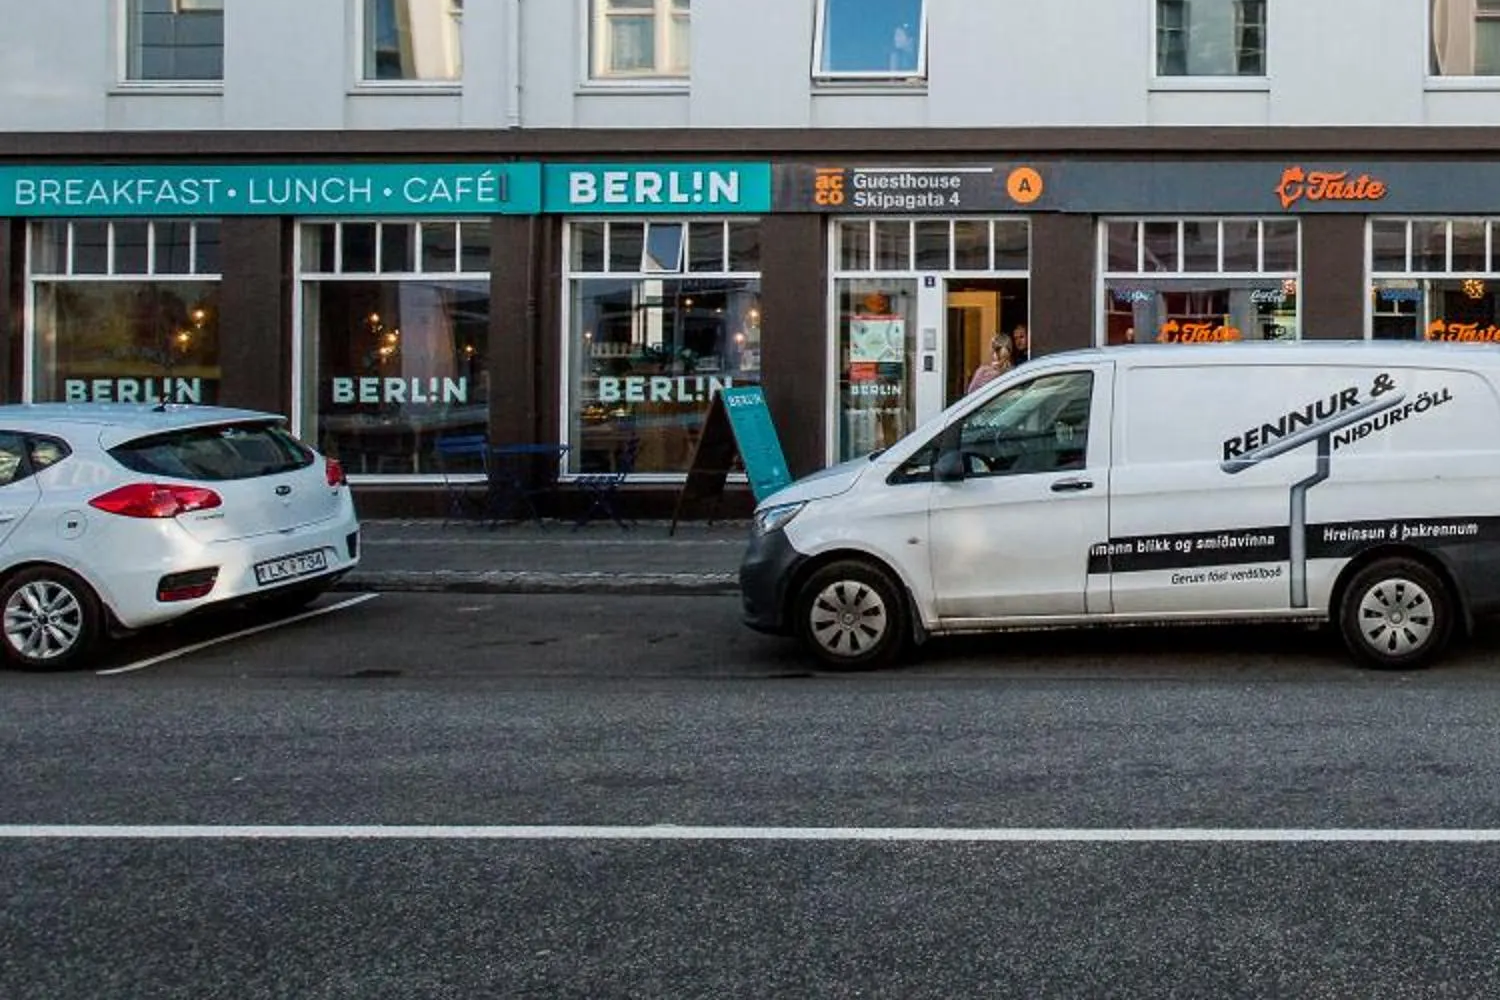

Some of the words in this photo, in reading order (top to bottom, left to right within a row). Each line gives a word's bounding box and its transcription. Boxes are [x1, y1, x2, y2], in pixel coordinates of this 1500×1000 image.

[15, 178, 221, 205] BREAKFAST
[249, 177, 371, 203] LUNCH
[403, 169, 495, 203] CAFÉ
[853, 173, 961, 189] Guesthouse
[1018, 177, 1031, 193] A
[1306, 170, 1388, 200] Taste
[853, 191, 945, 209] Skipagata
[949, 191, 960, 206] 4
[1223, 386, 1361, 461] RENNUR
[1370, 373, 1397, 397] &
[1323, 526, 1386, 542] Hreinsun
[1137, 539, 1171, 553] blikk
[1175, 538, 1191, 553] og
